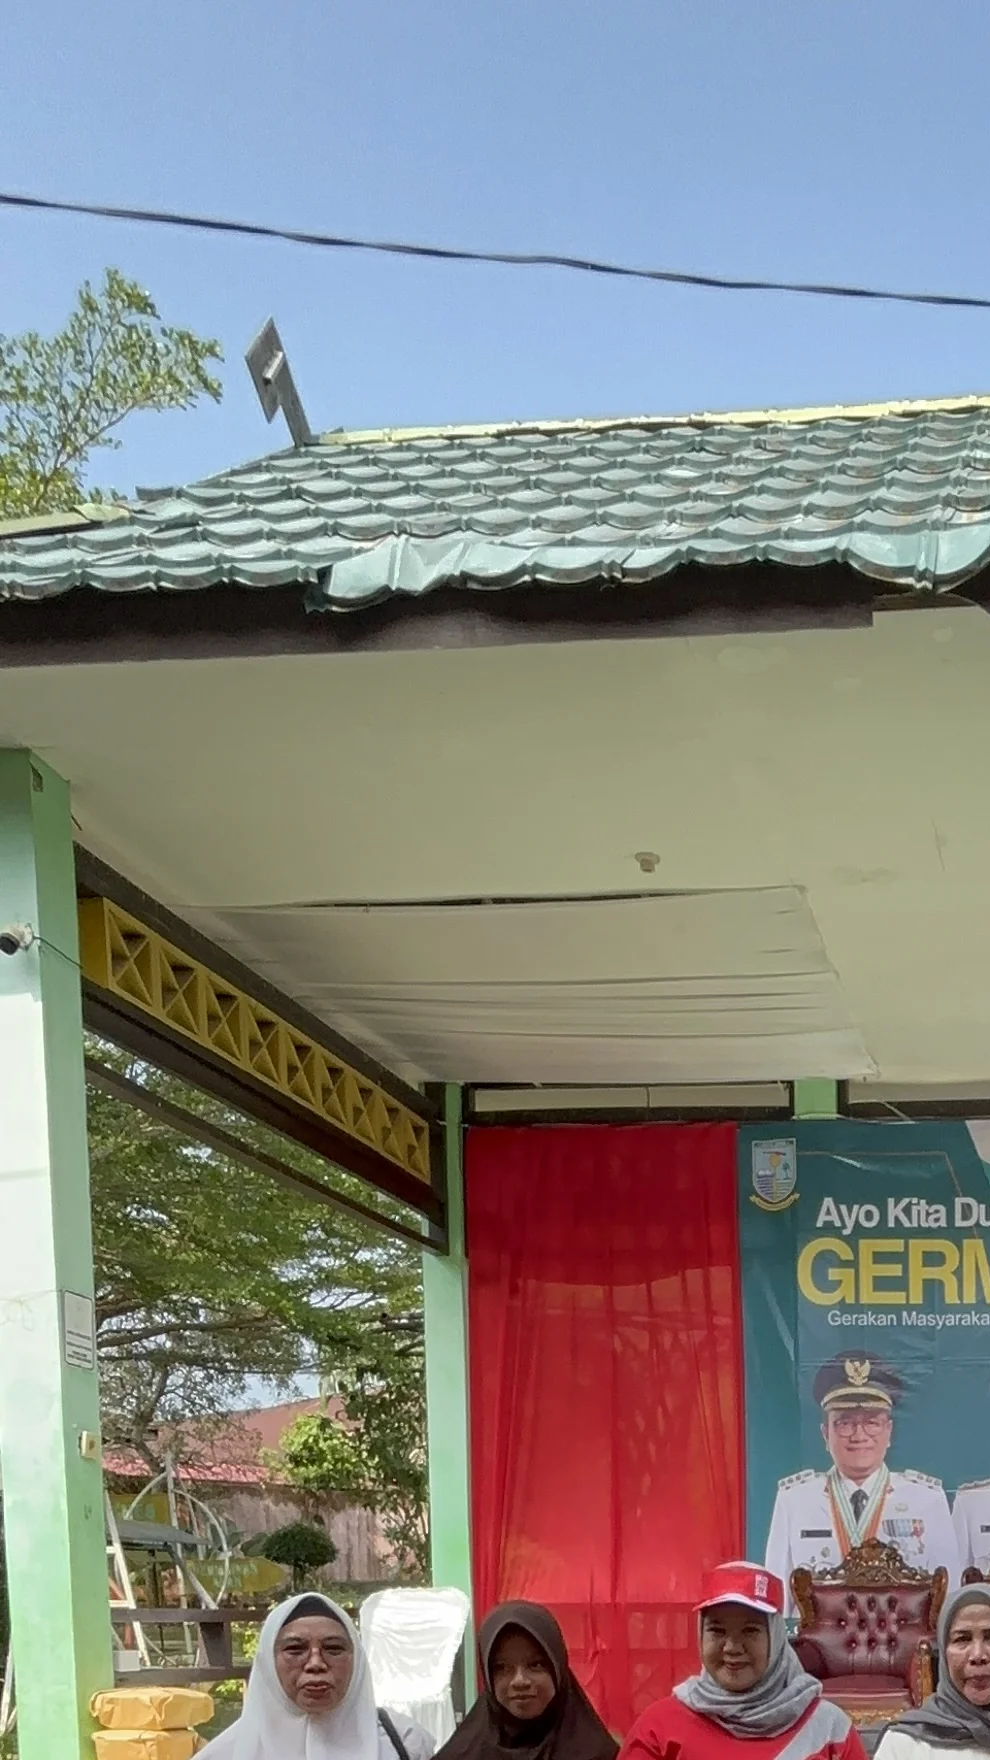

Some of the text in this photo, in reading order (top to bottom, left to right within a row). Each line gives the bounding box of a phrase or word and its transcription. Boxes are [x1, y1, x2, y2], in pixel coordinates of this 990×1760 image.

[816, 1197, 880, 1235] Ayo
[887, 1196, 947, 1228] Kita
[827, 1310, 897, 1327] Gerakan
